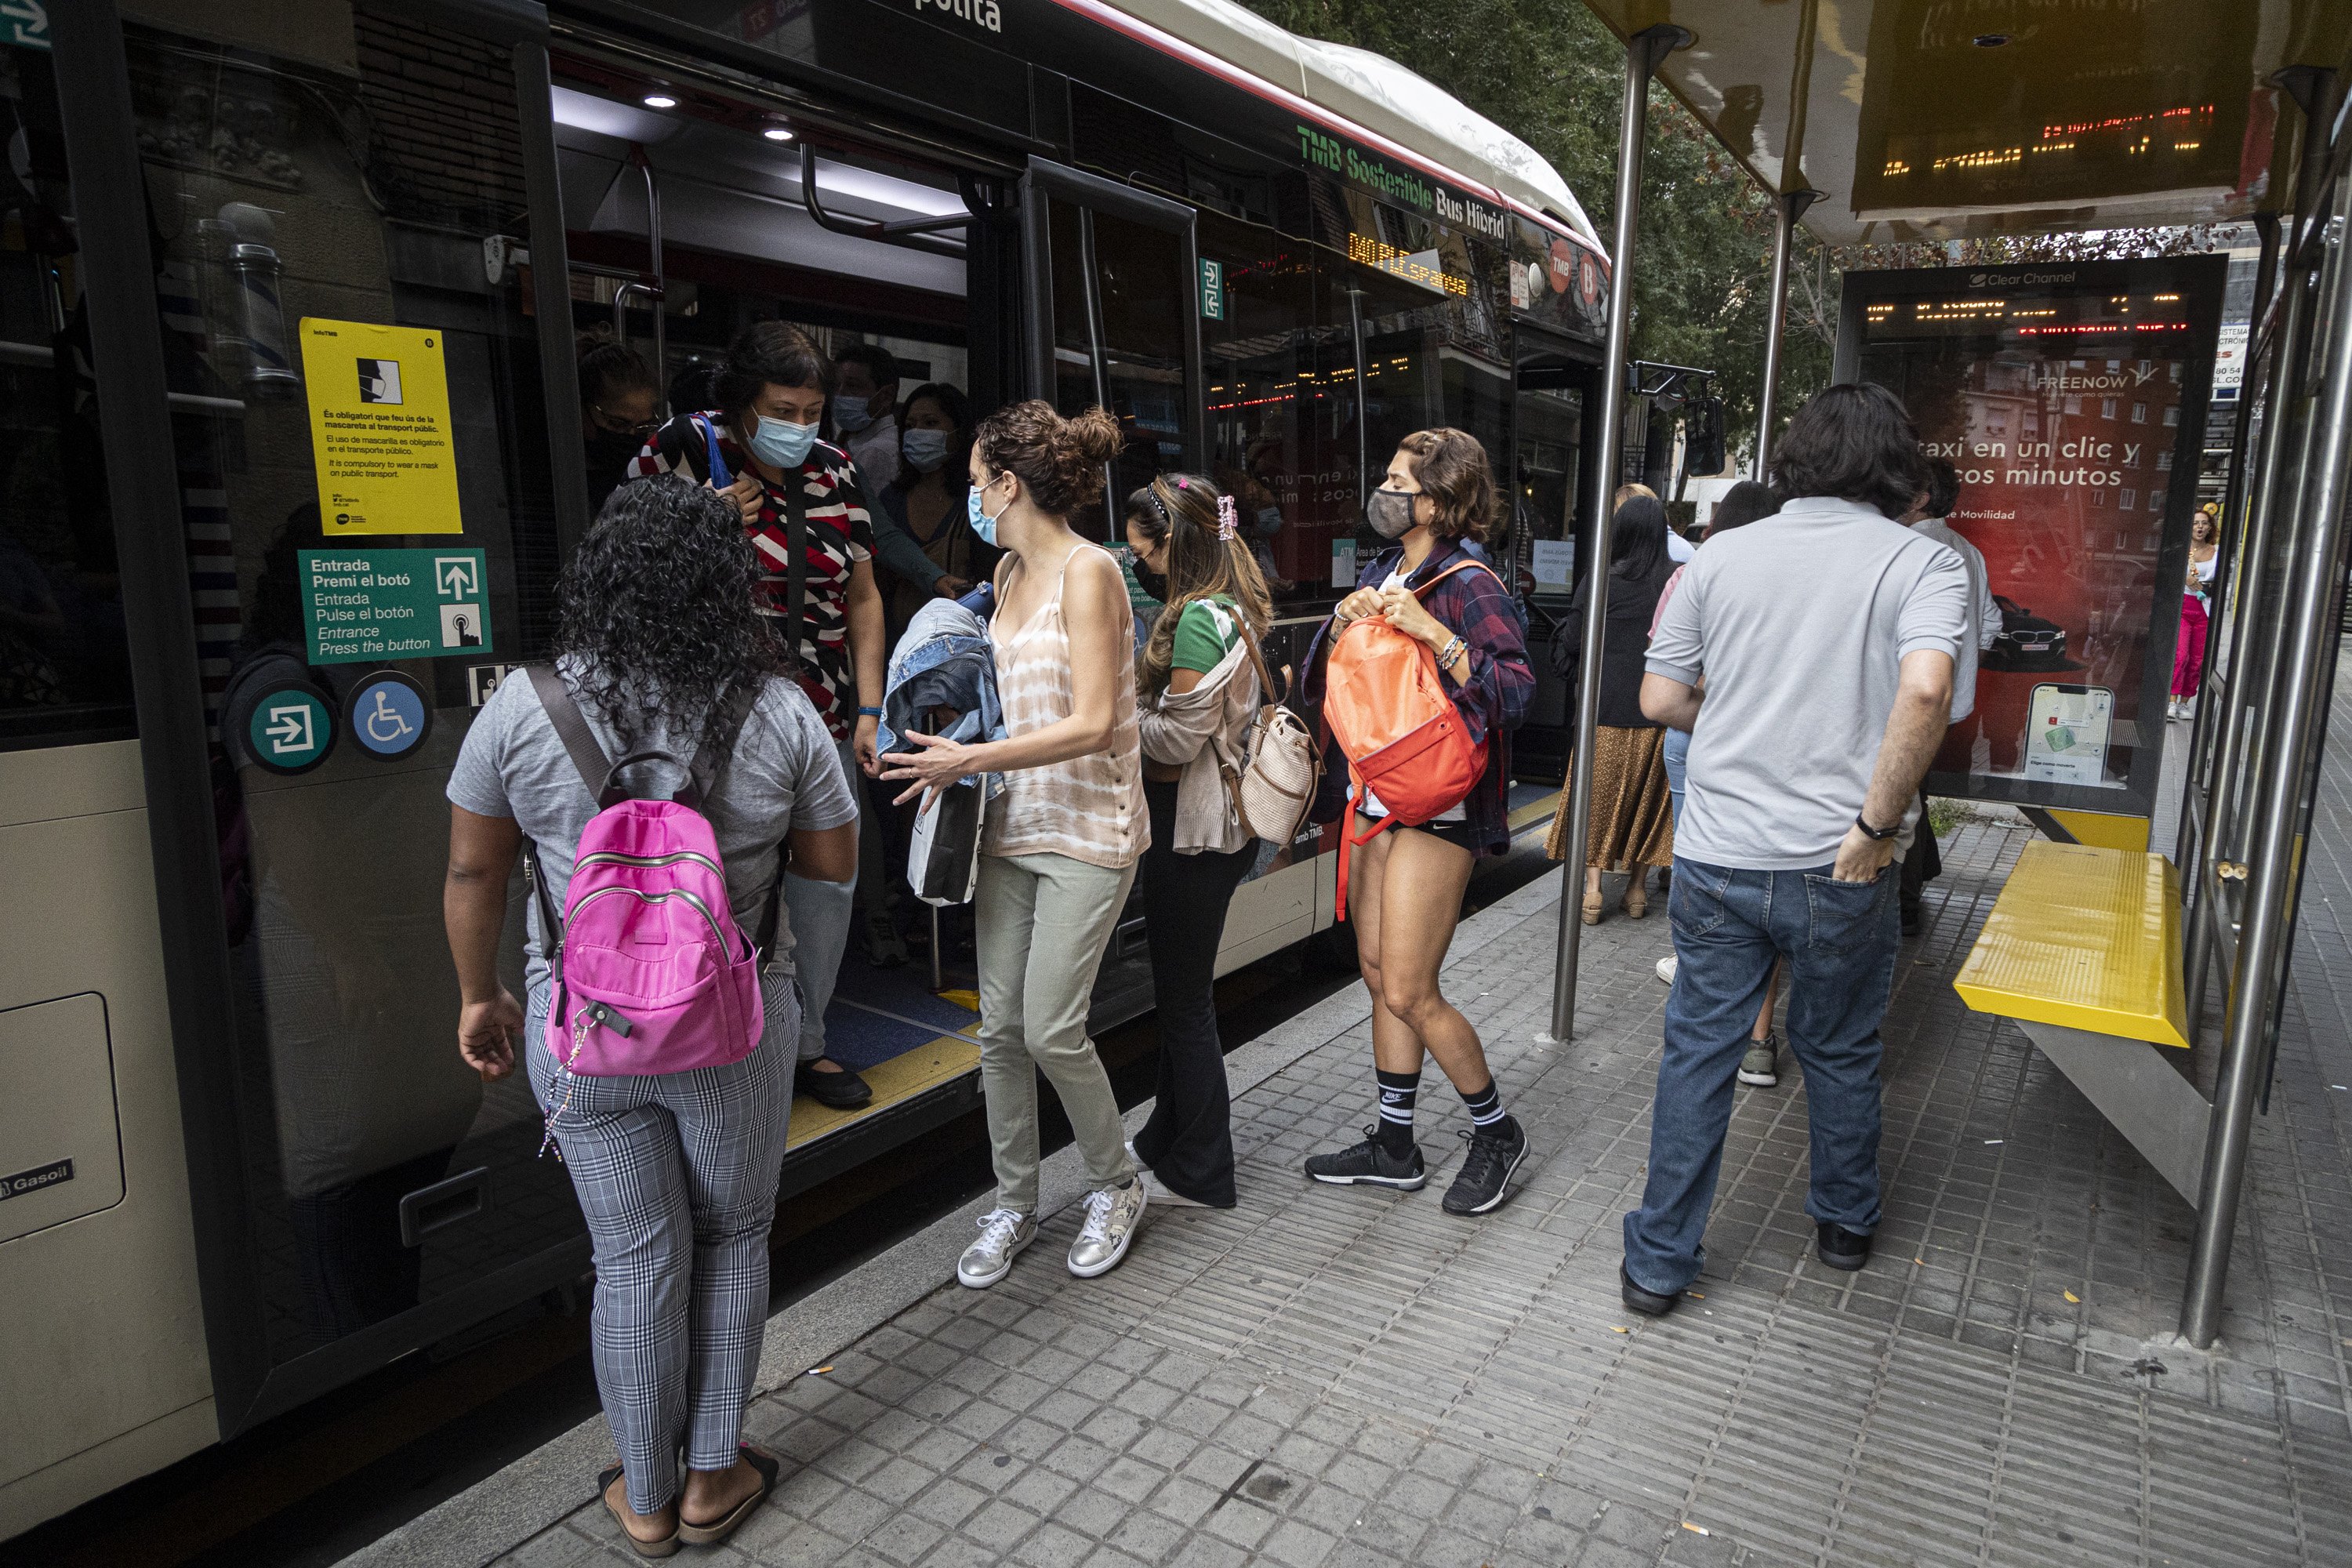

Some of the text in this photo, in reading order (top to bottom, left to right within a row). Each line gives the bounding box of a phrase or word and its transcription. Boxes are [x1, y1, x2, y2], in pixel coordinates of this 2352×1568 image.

[1297, 125, 1341, 172] TMB
[1346, 147, 1432, 210] Sostenible
[1436, 187, 1463, 222] Bus
[1349, 232, 1375, 266] D40
[1553, 256, 1570, 276] TMB
[1584, 263, 1593, 295] B
[1988, 271, 2076, 285] Clear Channel
[2037, 376, 2129, 389] FREENOW
[324, 409, 334, 418] És
[336, 412, 373, 421] obligatori
[406, 414, 415, 423] ús
[417, 414, 426, 423] de
[377, 423, 412, 433] transport
[415, 425, 439, 434] públic.
[409, 438, 445, 447] obligatorio
[347, 446, 384, 455] transporte
[386, 447, 414, 456] público.
[1973, 441, 2006, 458] en
[2016, 441, 2050, 459] un
[2062, 436, 2112, 459] clic
[2122, 443, 2142, 463] y
[343, 460, 386, 469] compulsory
[342, 470, 364, 478] public
[2005, 463, 2122, 486] minutos
[1960, 510, 2016, 520] Movilidad
[1369, 547, 1377, 557] de
[311, 559, 370, 572] Entrada
[314, 573, 411, 588] Premi el botó
[315, 593, 370, 606] Entrada
[317, 605, 414, 622] Pulse el botón
[318, 627, 379, 640] Entrance
[320, 638, 430, 655] Press the button
[1295, 831, 1309, 844] amb
[13, 1165, 67, 1190] Gasoil
